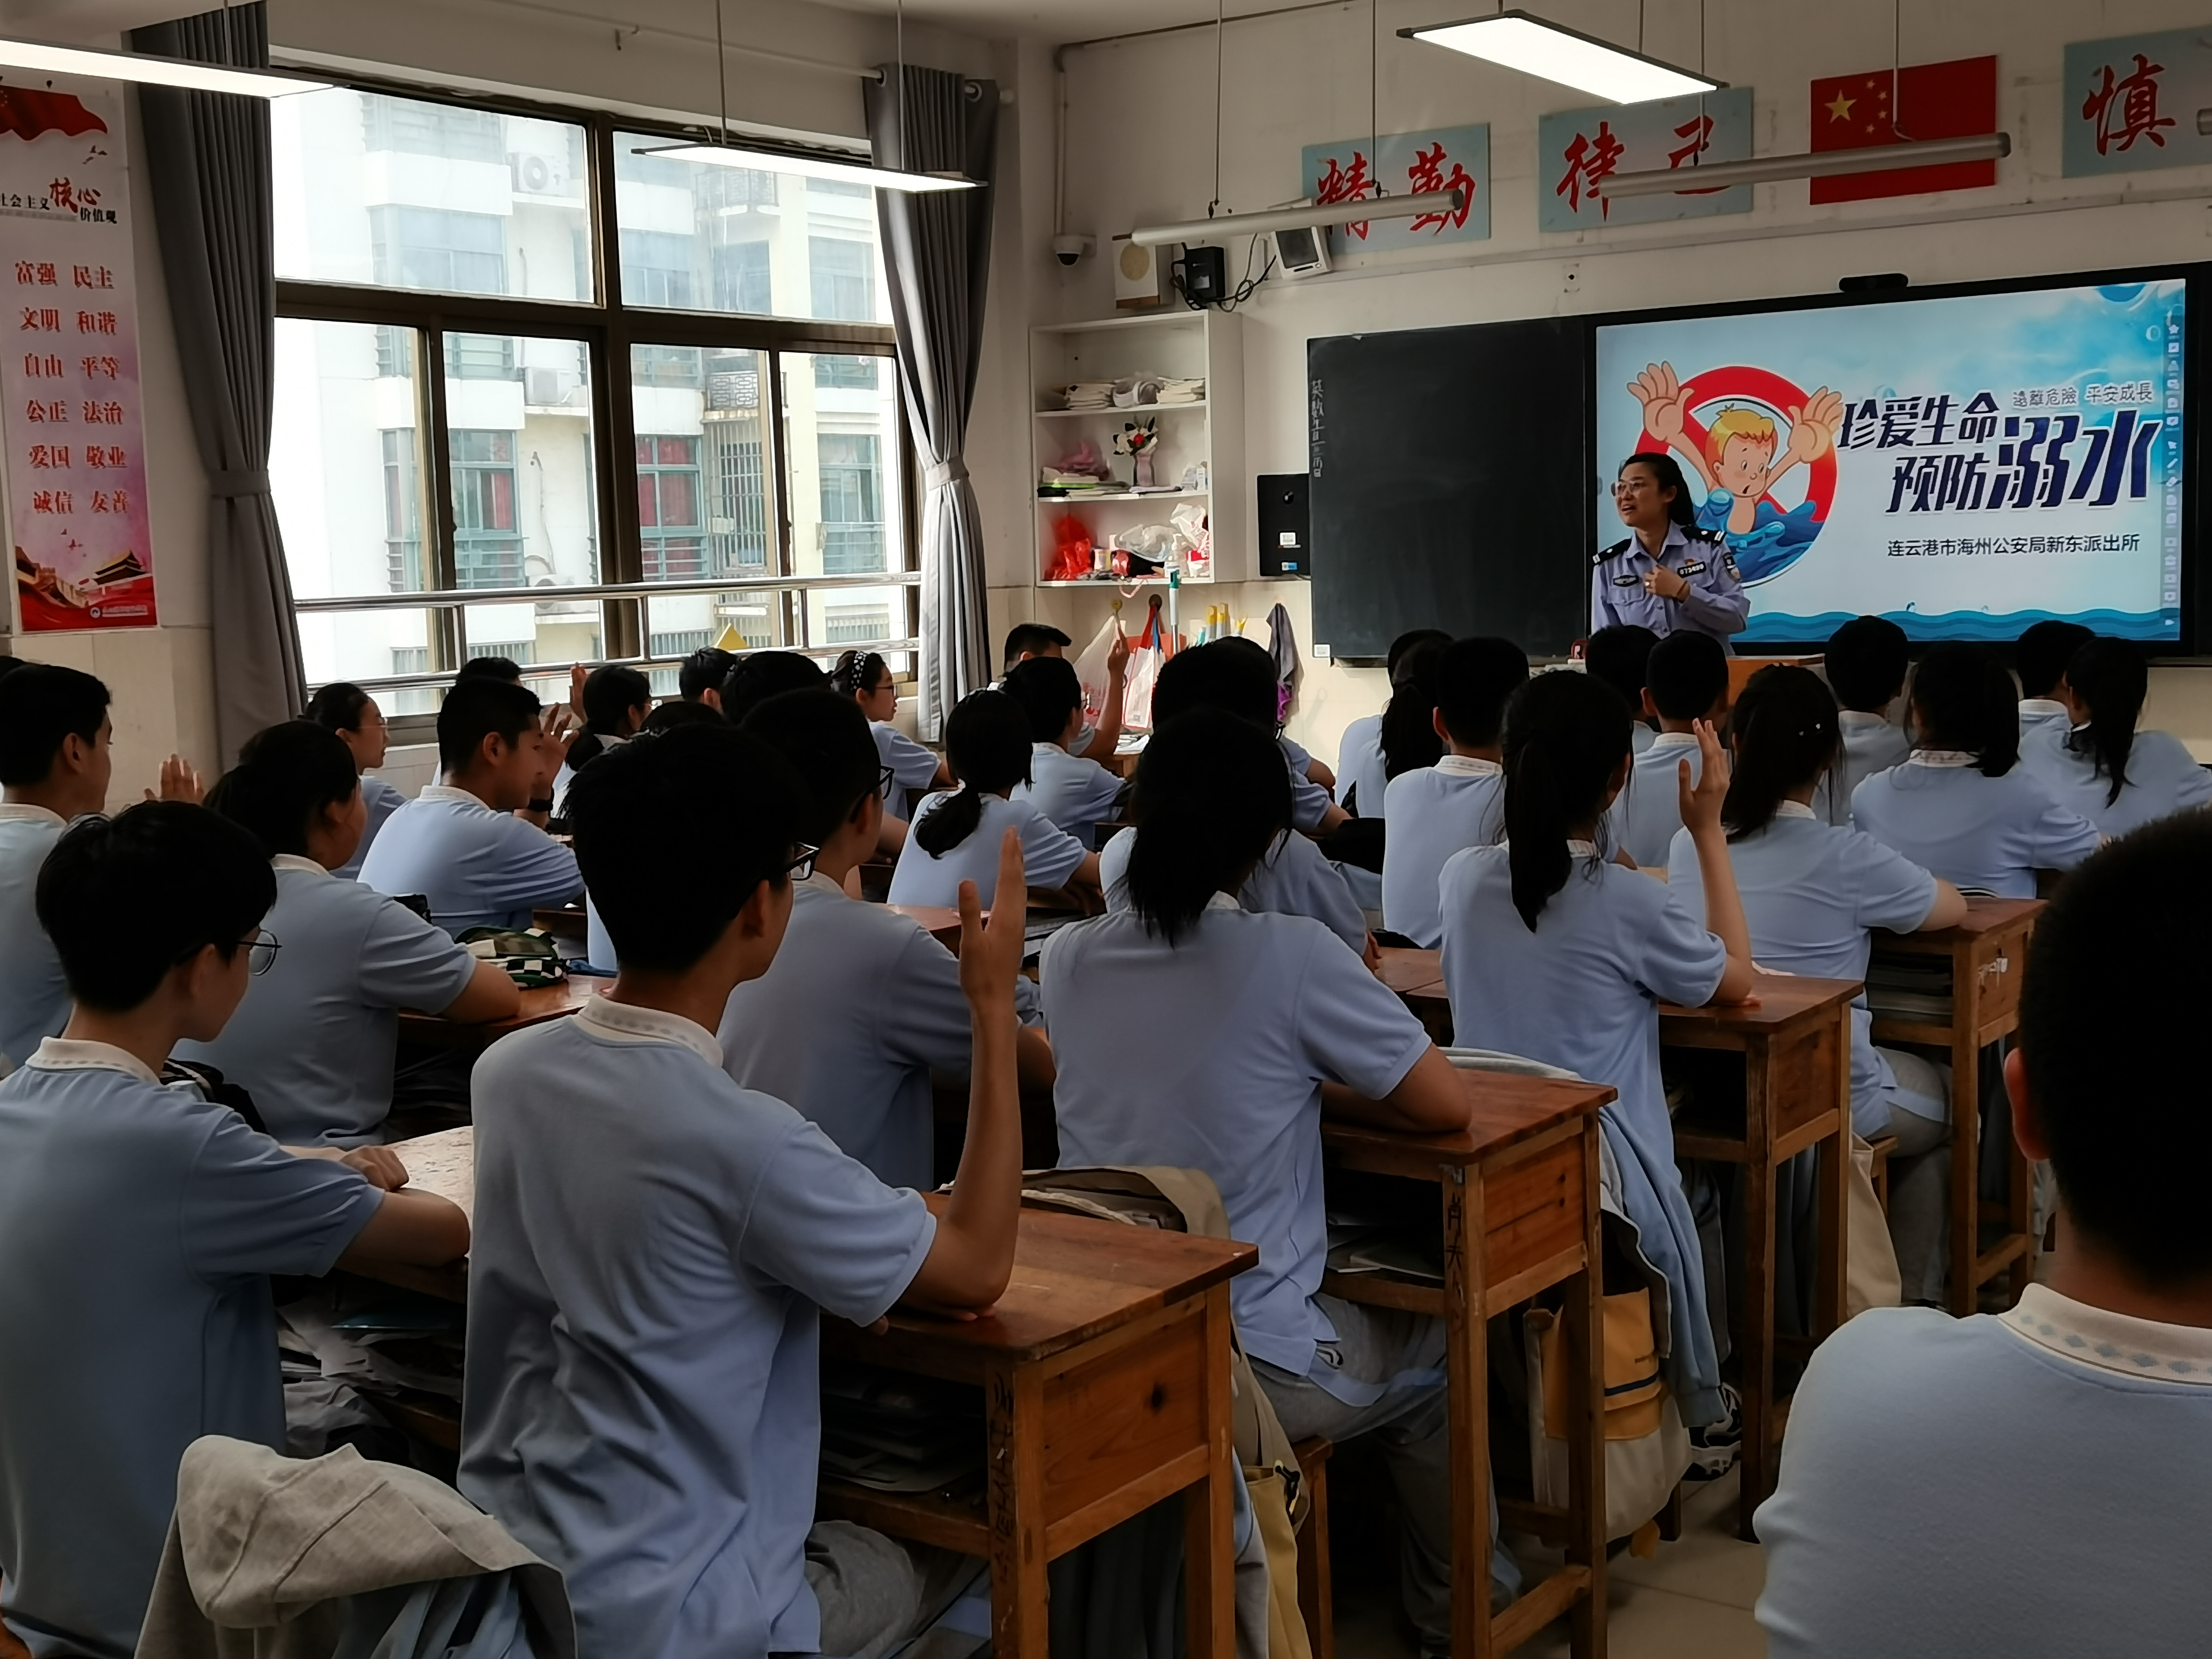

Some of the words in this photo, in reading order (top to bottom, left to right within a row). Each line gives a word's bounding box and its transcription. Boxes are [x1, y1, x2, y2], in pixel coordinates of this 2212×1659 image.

[2082, 53, 2176, 156] 慎
[49, 177, 101, 213] 核心
[15, 260, 58, 287] 富强
[73, 264, 115, 289] 民主
[19, 307, 61, 333] 文明
[76, 311, 117, 336] 和谐
[24, 353, 64, 378] 自由
[80, 356, 120, 381] 平等
[2086, 383, 2152, 403] 平安成長
[27, 399, 69, 423] 公正
[82, 400, 123, 425] 法治
[1838, 393, 2000, 449] 珍爱生命
[29, 445, 71, 469] 爱国
[86, 445, 128, 469] 敬业
[1886, 409, 2161, 513] 预防溺水
[33, 490, 73, 514] 诚信
[91, 490, 128, 513] 友善
[1887, 534, 2140, 557] 连云港市海州公安局新东派出所
